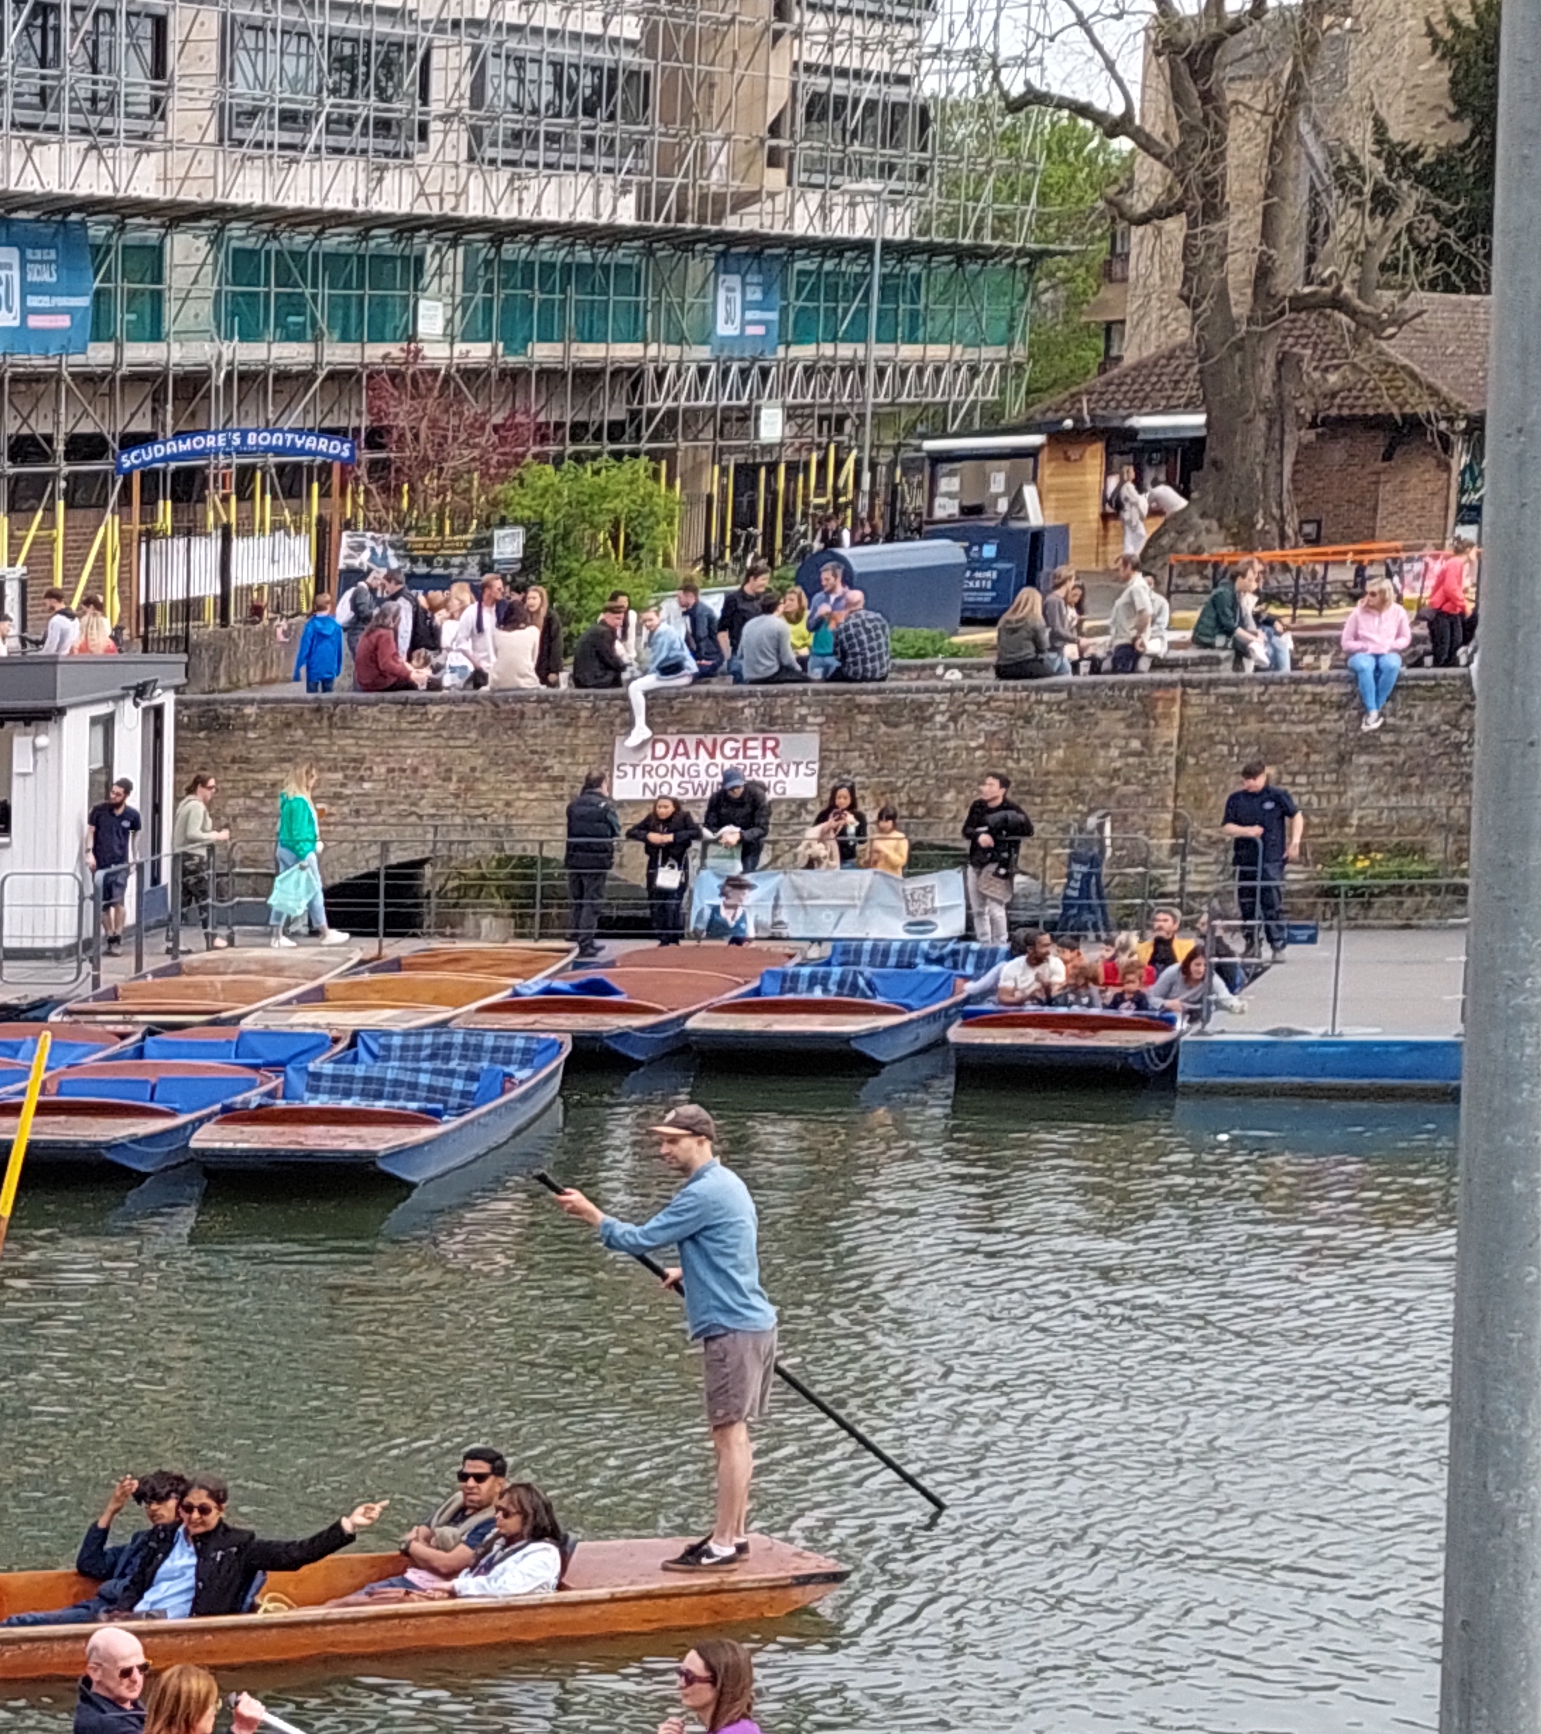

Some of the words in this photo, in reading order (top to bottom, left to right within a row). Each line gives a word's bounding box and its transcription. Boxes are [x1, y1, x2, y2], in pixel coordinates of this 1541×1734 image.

[120, 432, 242, 469] SCUDAMORE'S
[247, 432, 353, 459] BOATYARDS
[650, 736, 781, 761] DANGER
[616, 762, 701, 780] STRONG
[642, 781, 673, 798] NO
